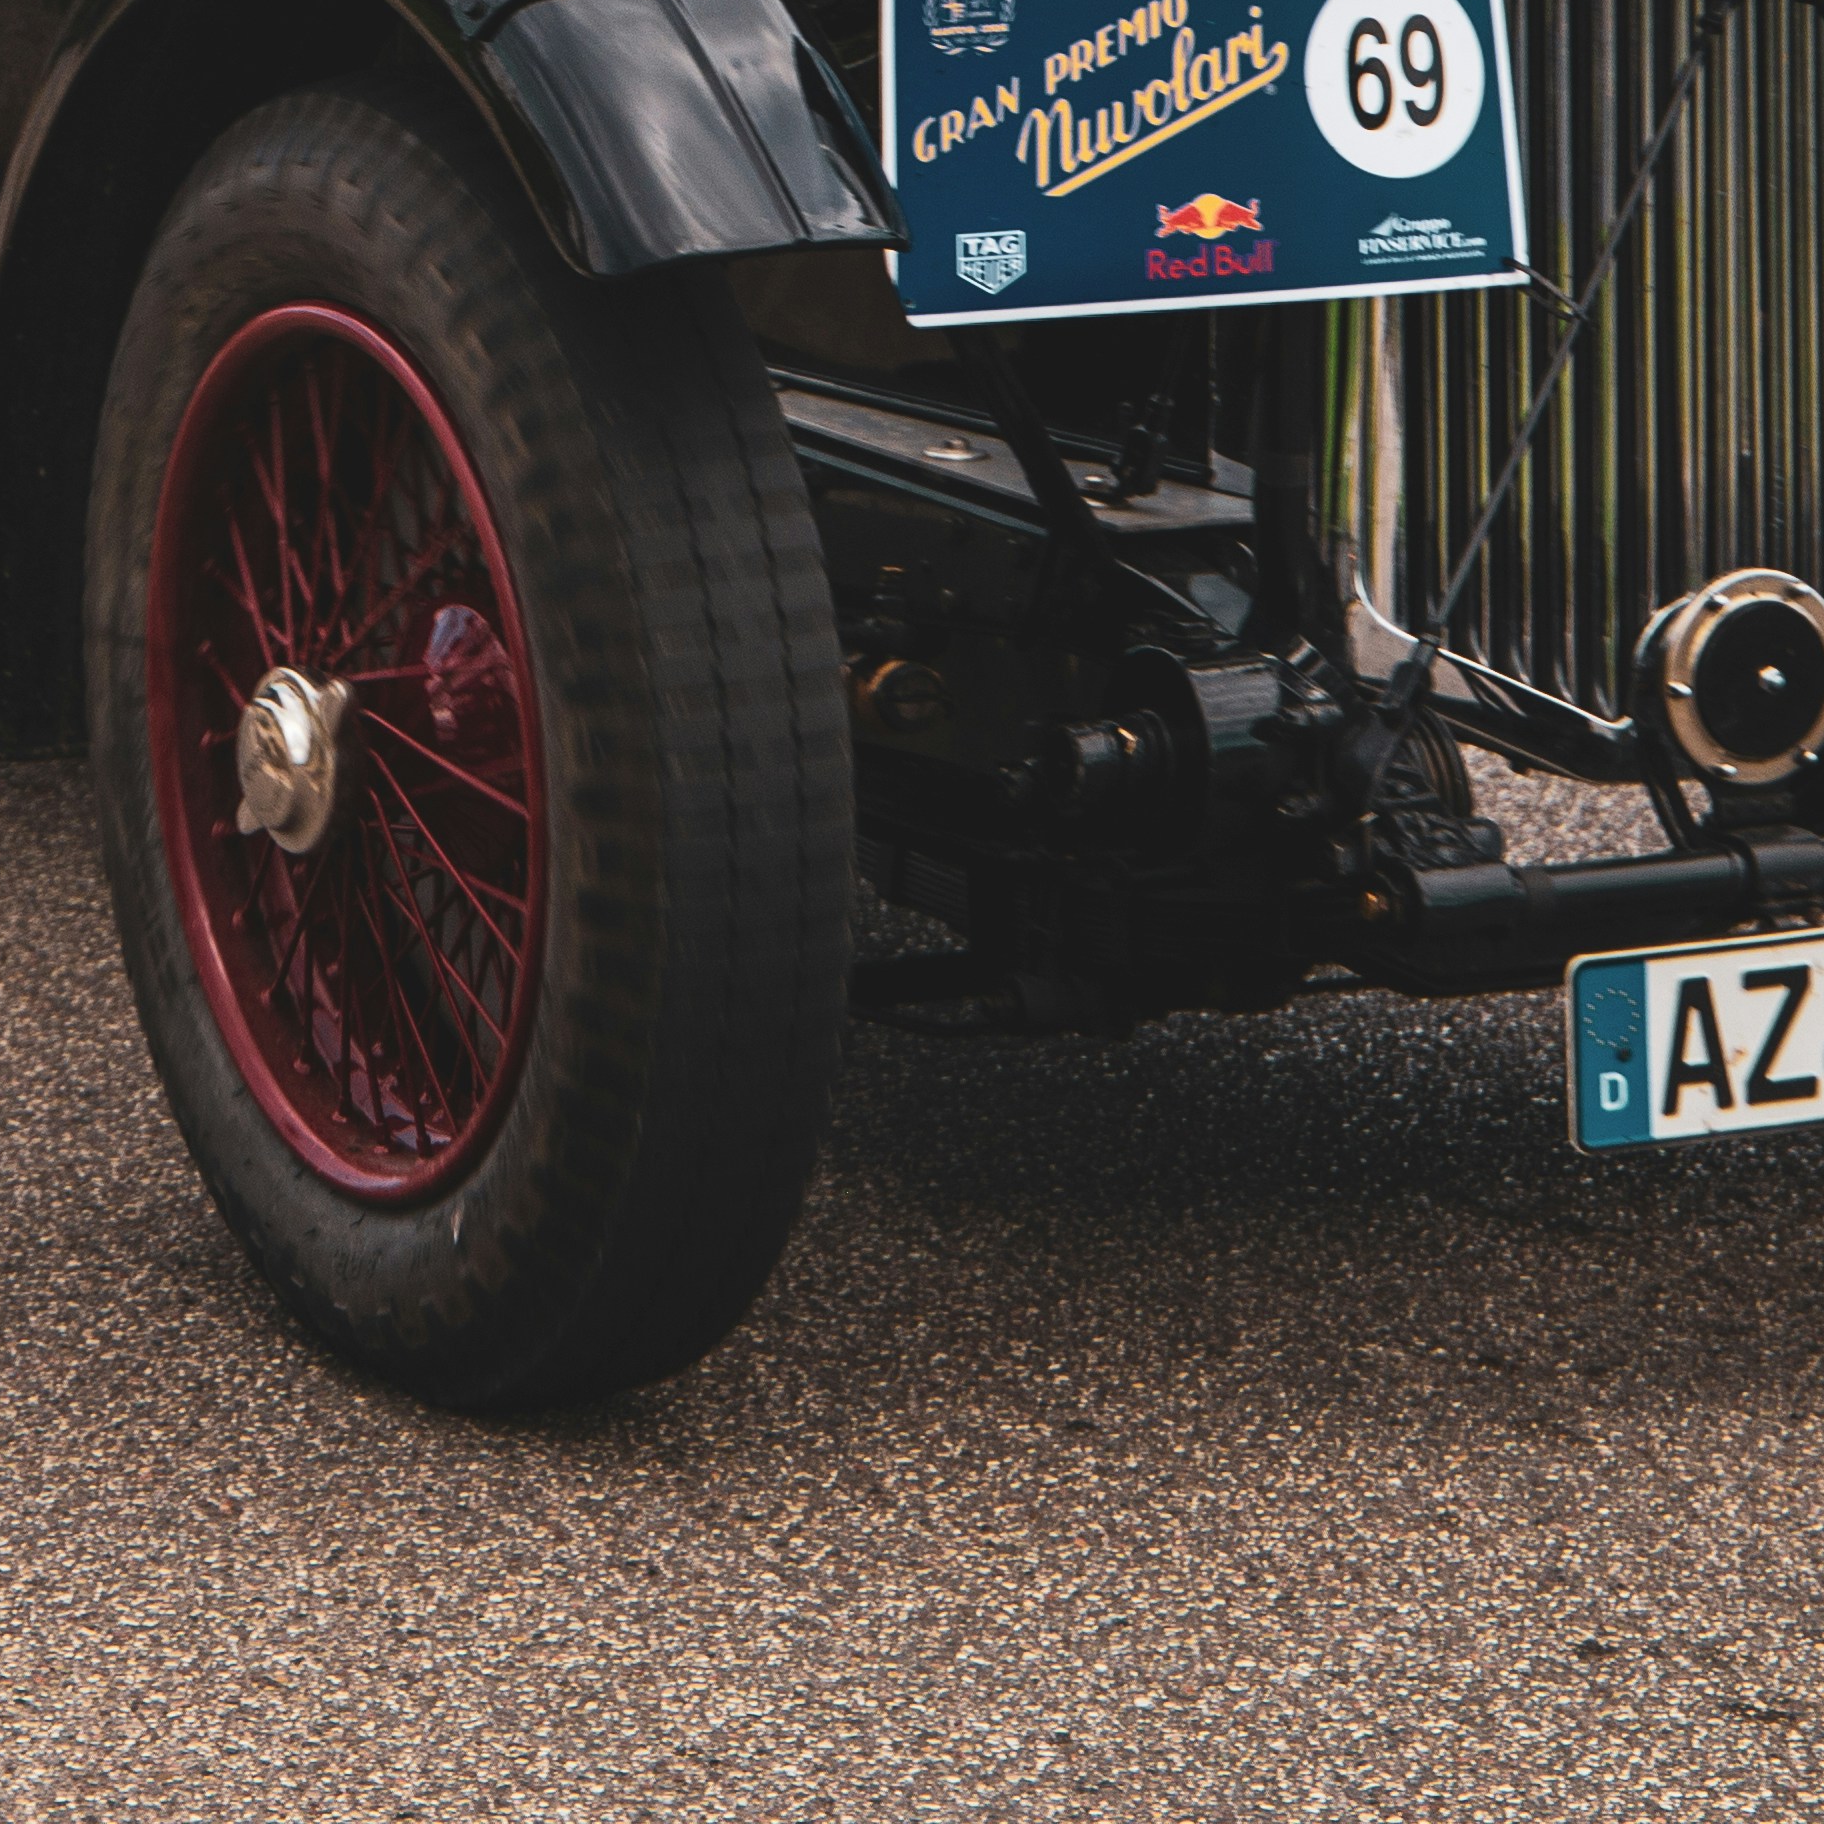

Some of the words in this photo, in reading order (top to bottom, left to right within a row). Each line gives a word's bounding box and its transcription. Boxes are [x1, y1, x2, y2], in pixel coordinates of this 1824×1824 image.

[1016, 5, 1290, 189] Nuvolari
[1348, 13, 1445, 131] 69
[912, 76, 1021, 163] GRAN
[961, 235, 1021, 256] TAG
[1147, 243, 1207, 279] Red
[1214, 240, 1273, 276] Bull
[1663, 963, 1819, 1116] AZ
[1599, 1071, 1628, 1111] D
